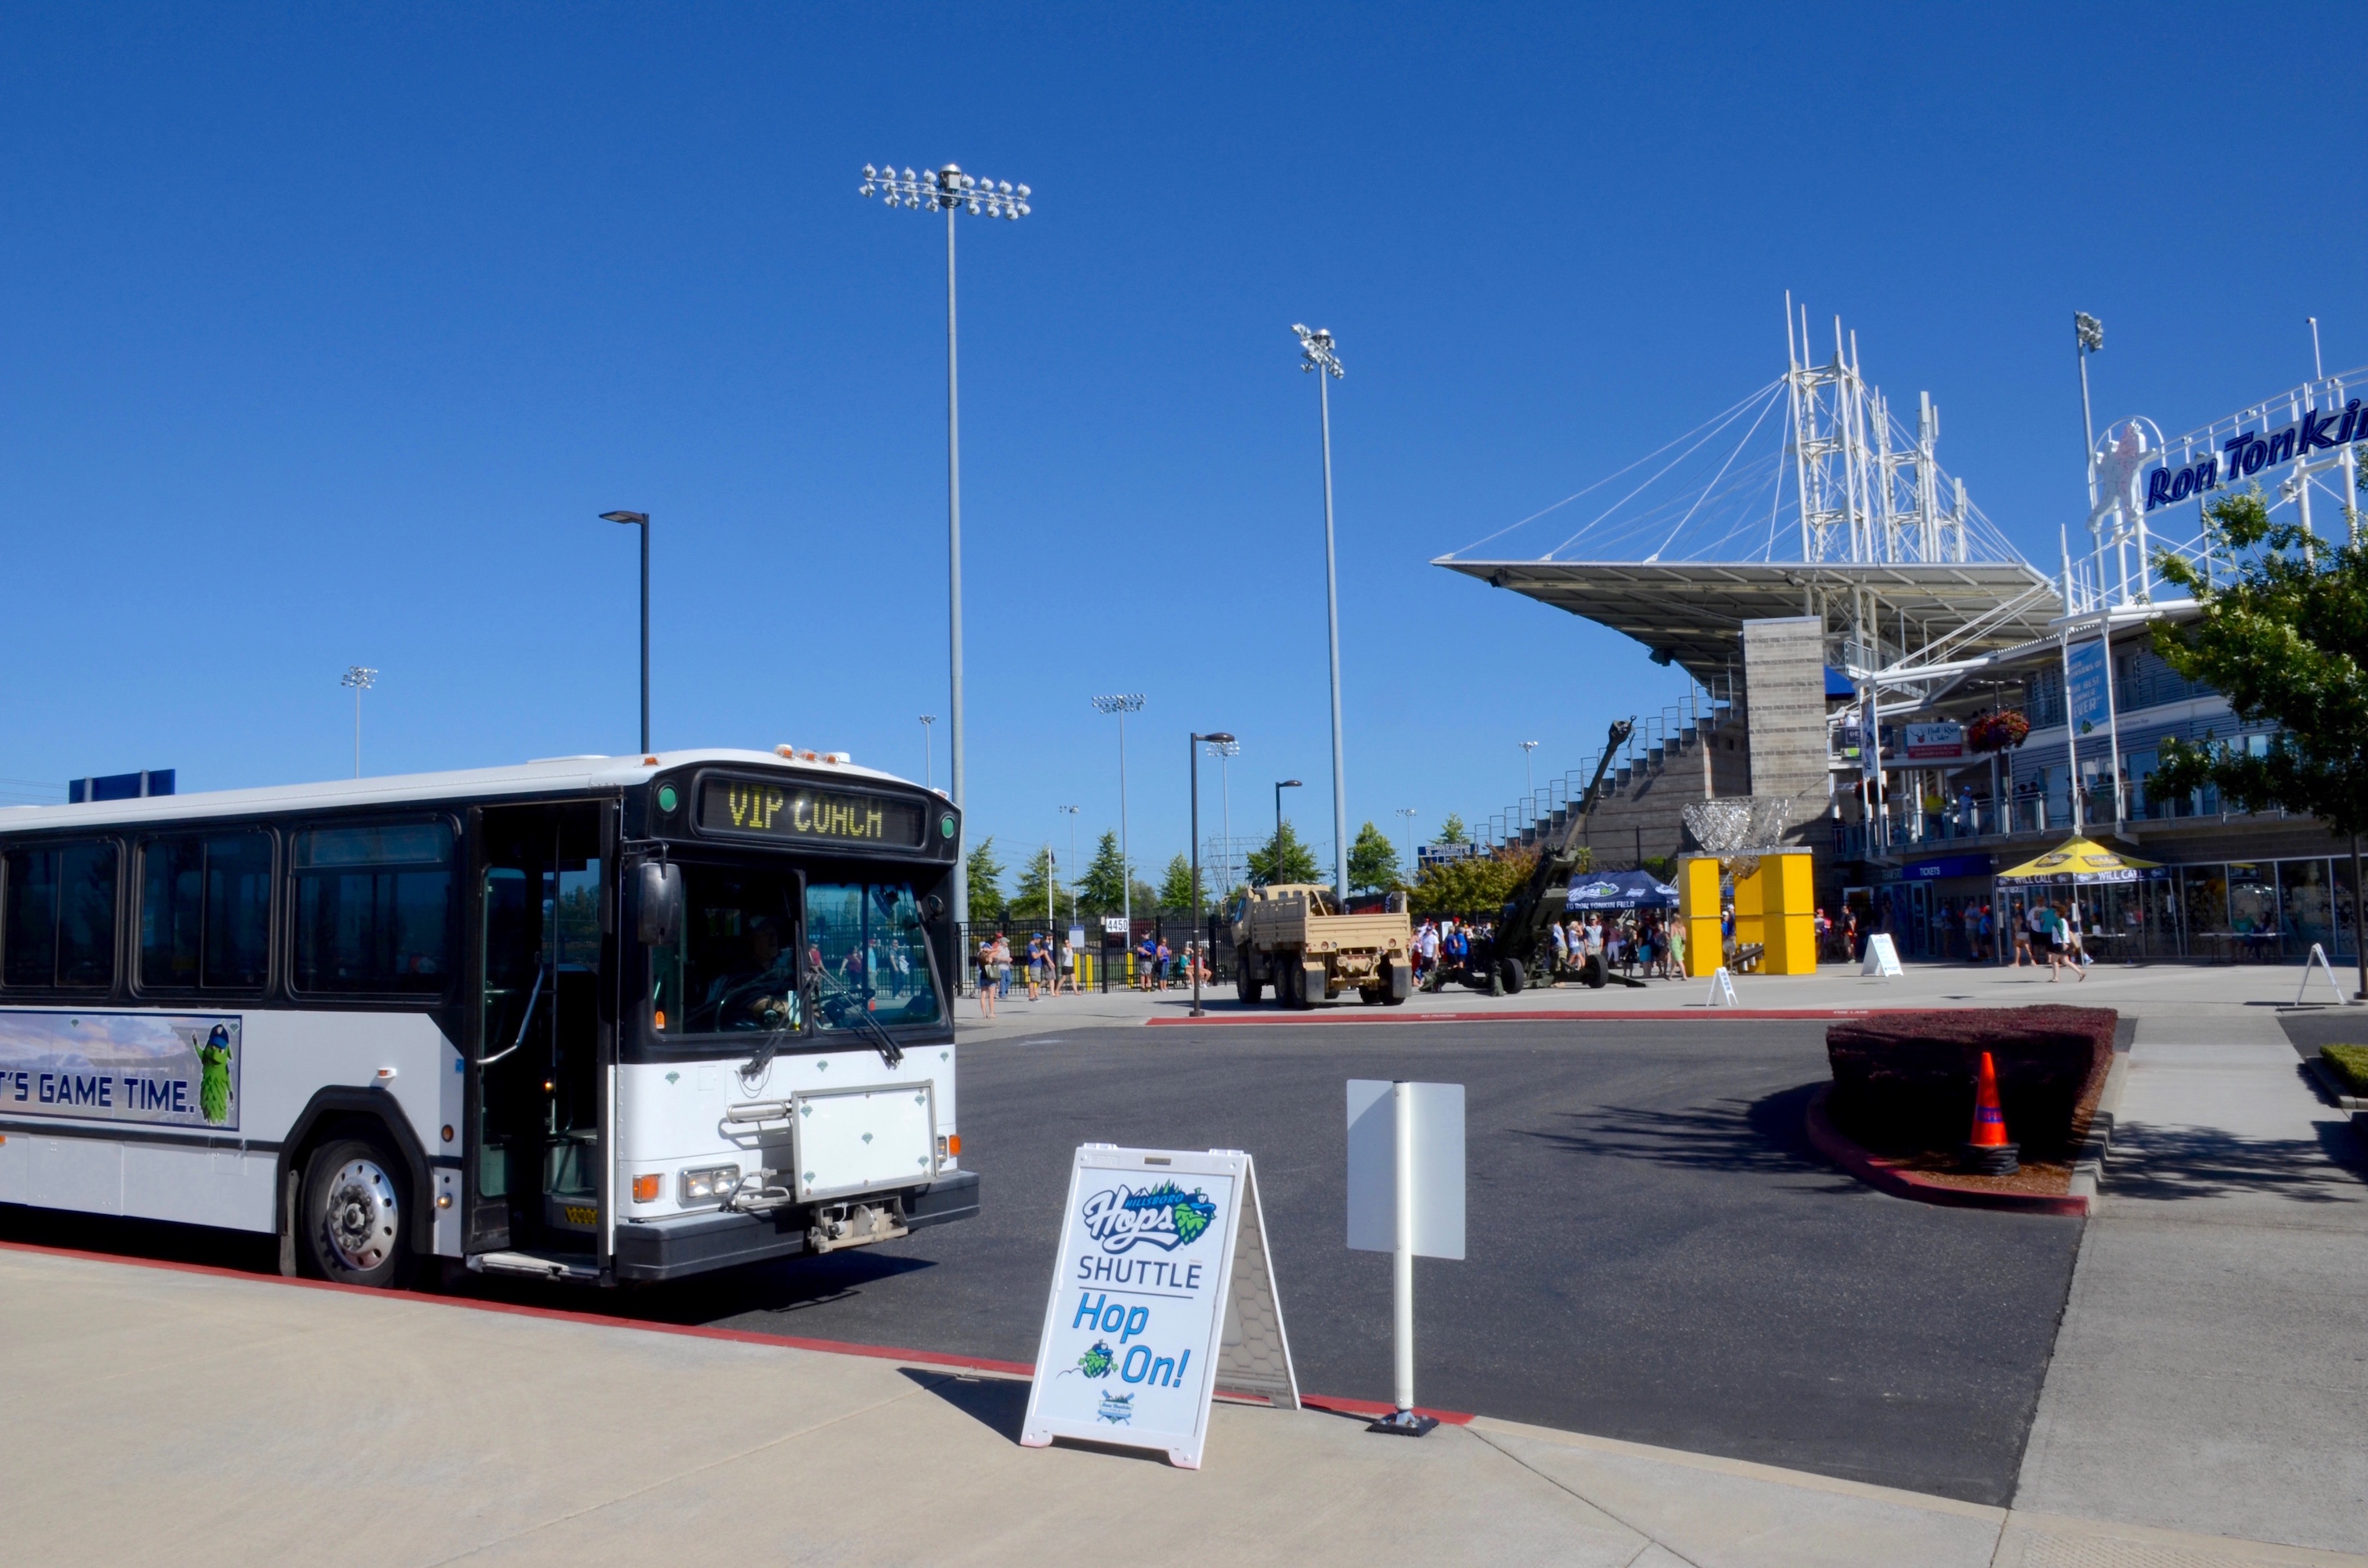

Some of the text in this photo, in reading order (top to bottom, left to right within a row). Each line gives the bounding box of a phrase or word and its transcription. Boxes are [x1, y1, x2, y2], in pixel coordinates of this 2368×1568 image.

[2146, 457, 2218, 511] Ron
[729, 782, 882, 838] VIP COACH
[1919, 867, 1940, 876] TICKETS
[2034, 874, 2052, 883] CALL
[2098, 870, 2144, 881] WILL CALL
[1108, 919, 1128, 931] 4450
[39, 1072, 113, 1108] GAME
[124, 1077, 194, 1113] TIME.
[1083, 1184, 1179, 1253] Hops
[1124, 1193, 1184, 1208] HILLSBORO
[1077, 1255, 1203, 1289] SHUTTLE
[1072, 1292, 1150, 1344] Hop
[1121, 1345, 1191, 1388] On!
